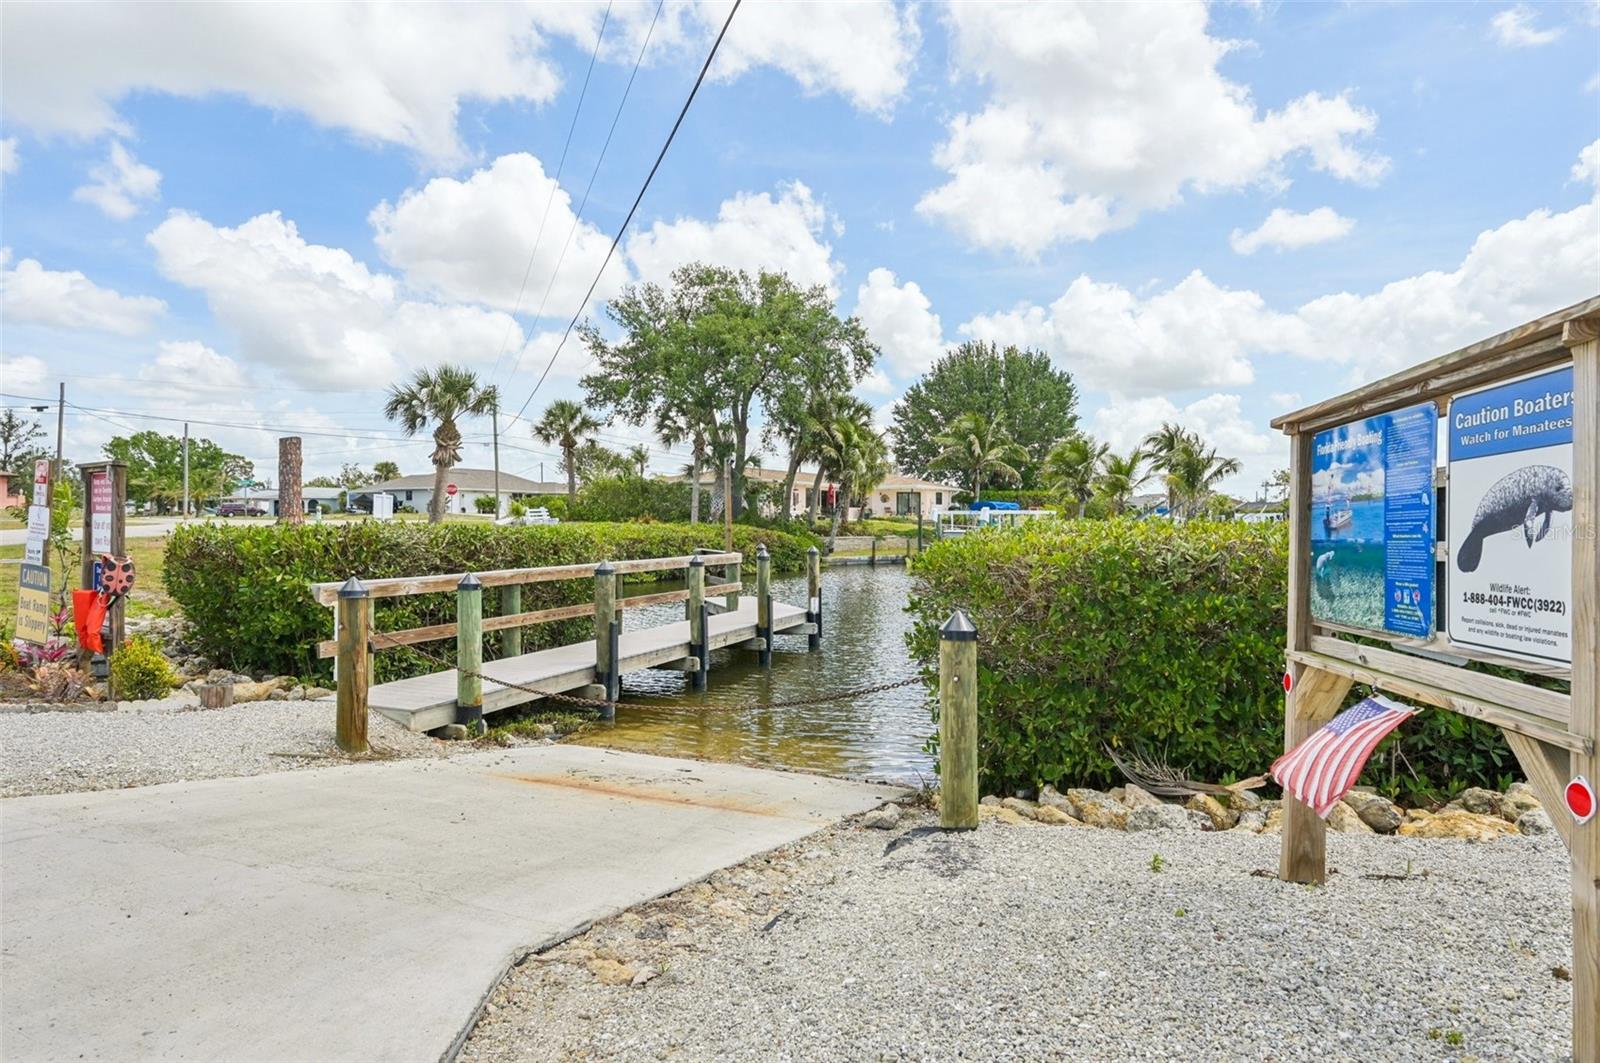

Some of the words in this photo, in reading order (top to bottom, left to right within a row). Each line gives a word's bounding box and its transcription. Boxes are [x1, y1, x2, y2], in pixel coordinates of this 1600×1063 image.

[1456, 406, 1509, 429] Caution
[1460, 431, 1491, 446] Watch
[1494, 429, 1509, 439] for
[1512, 416, 1573, 437] Manatees
[22, 567, 48, 587] CAUTION
[1489, 583, 1512, 594] Wildlife
[1513, 585, 1531, 595] Alert:
[20, 596, 32, 610] Boat
[33, 599, 47, 616] Ramp
[1463, 592, 1566, 616] 1-888-404-FWCC(3922)
[24, 614, 46, 634] Slippery
[1461, 616, 1475, 624] Report
[1524, 625, 1542, 634] injured
[1505, 633, 1523, 642] boating
